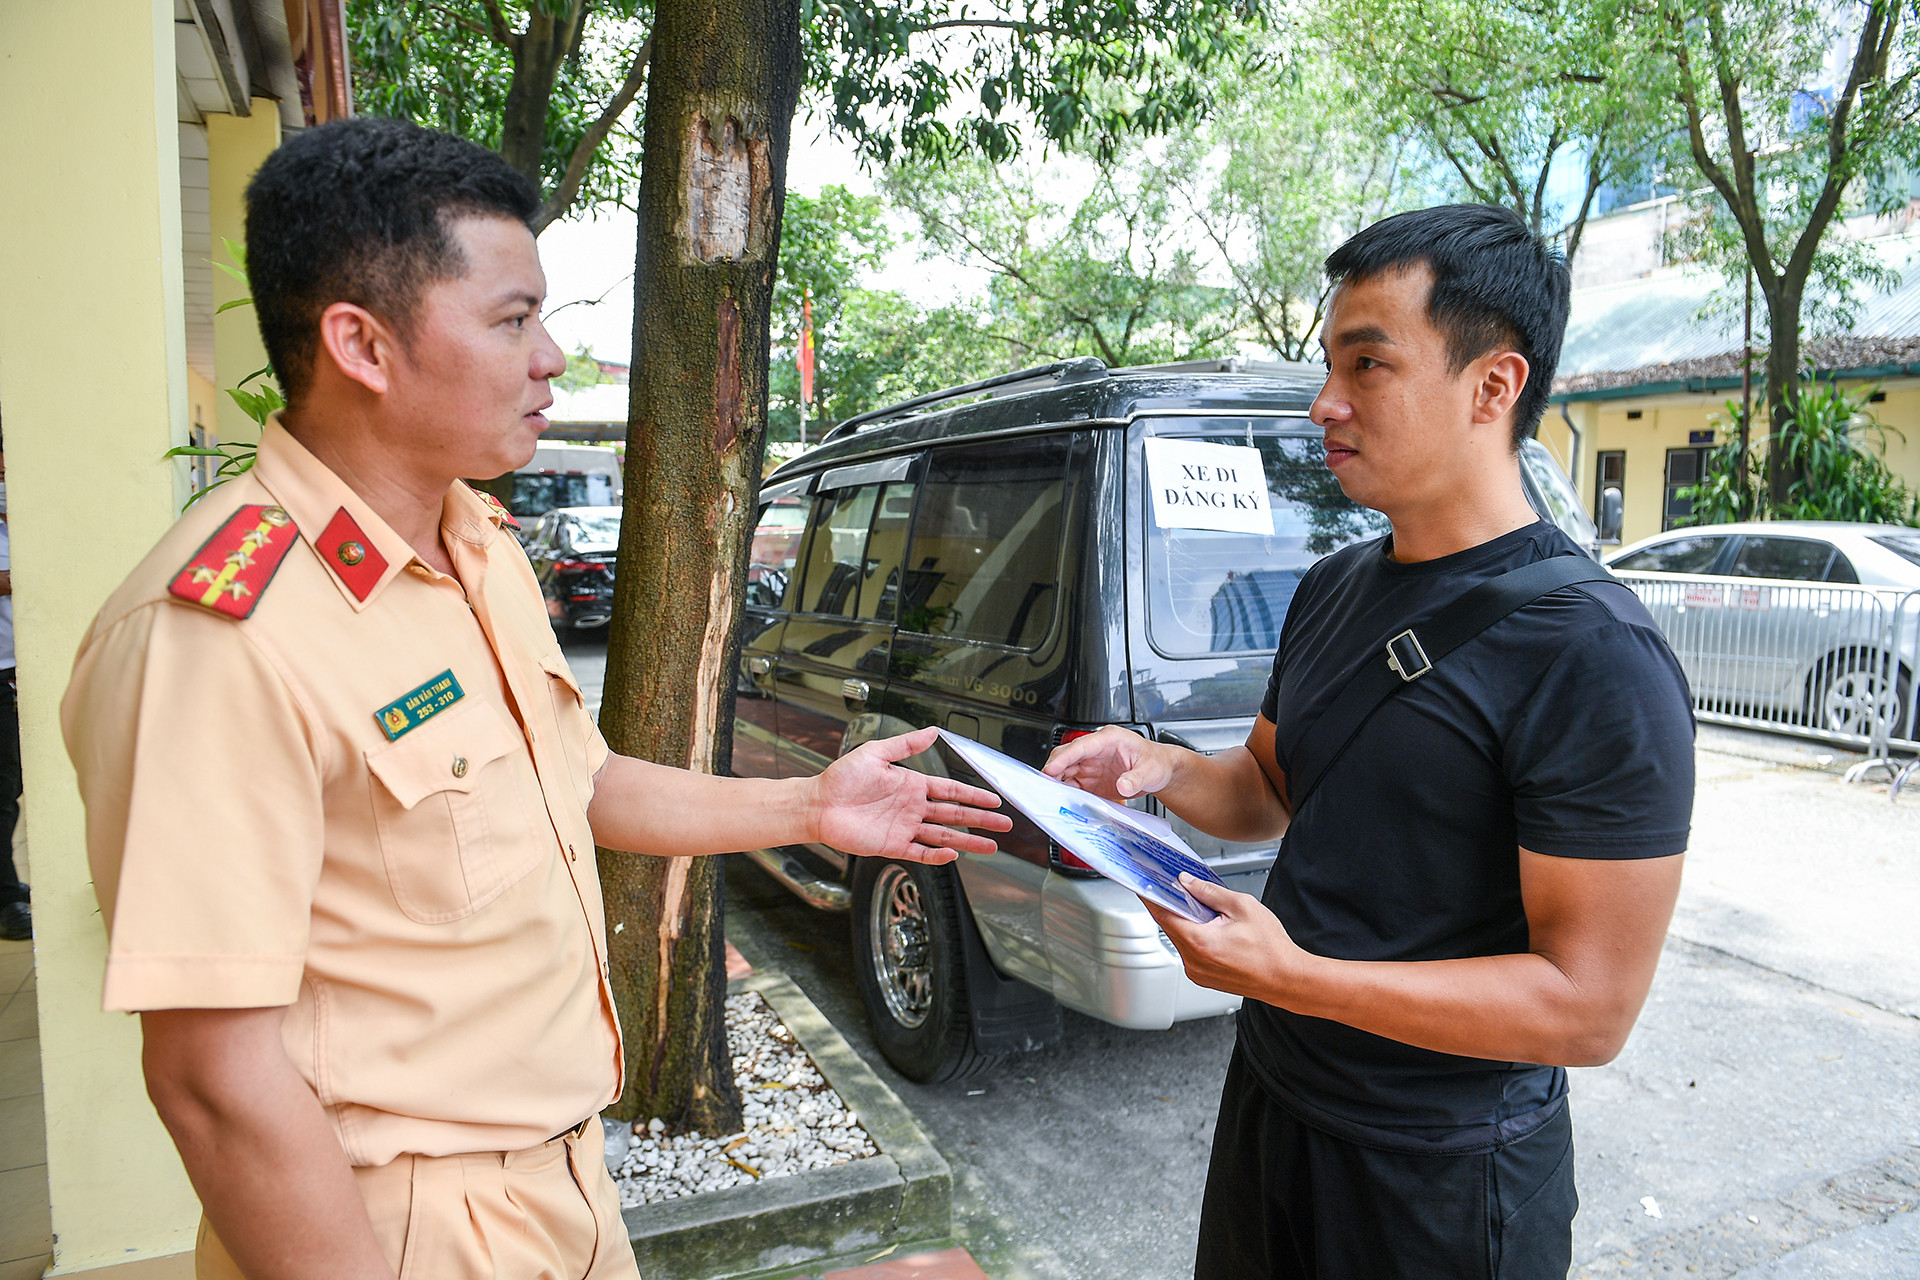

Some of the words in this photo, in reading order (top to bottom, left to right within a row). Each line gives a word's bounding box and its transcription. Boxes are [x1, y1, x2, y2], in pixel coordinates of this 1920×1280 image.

[1181, 464, 1210, 481] XE
[1232, 490, 1260, 510] KÝ
[964, 676, 984, 693] V6
[988, 682, 1037, 705] 3000
[416, 703, 434, 719] 253
[438, 691, 454, 706] 310
